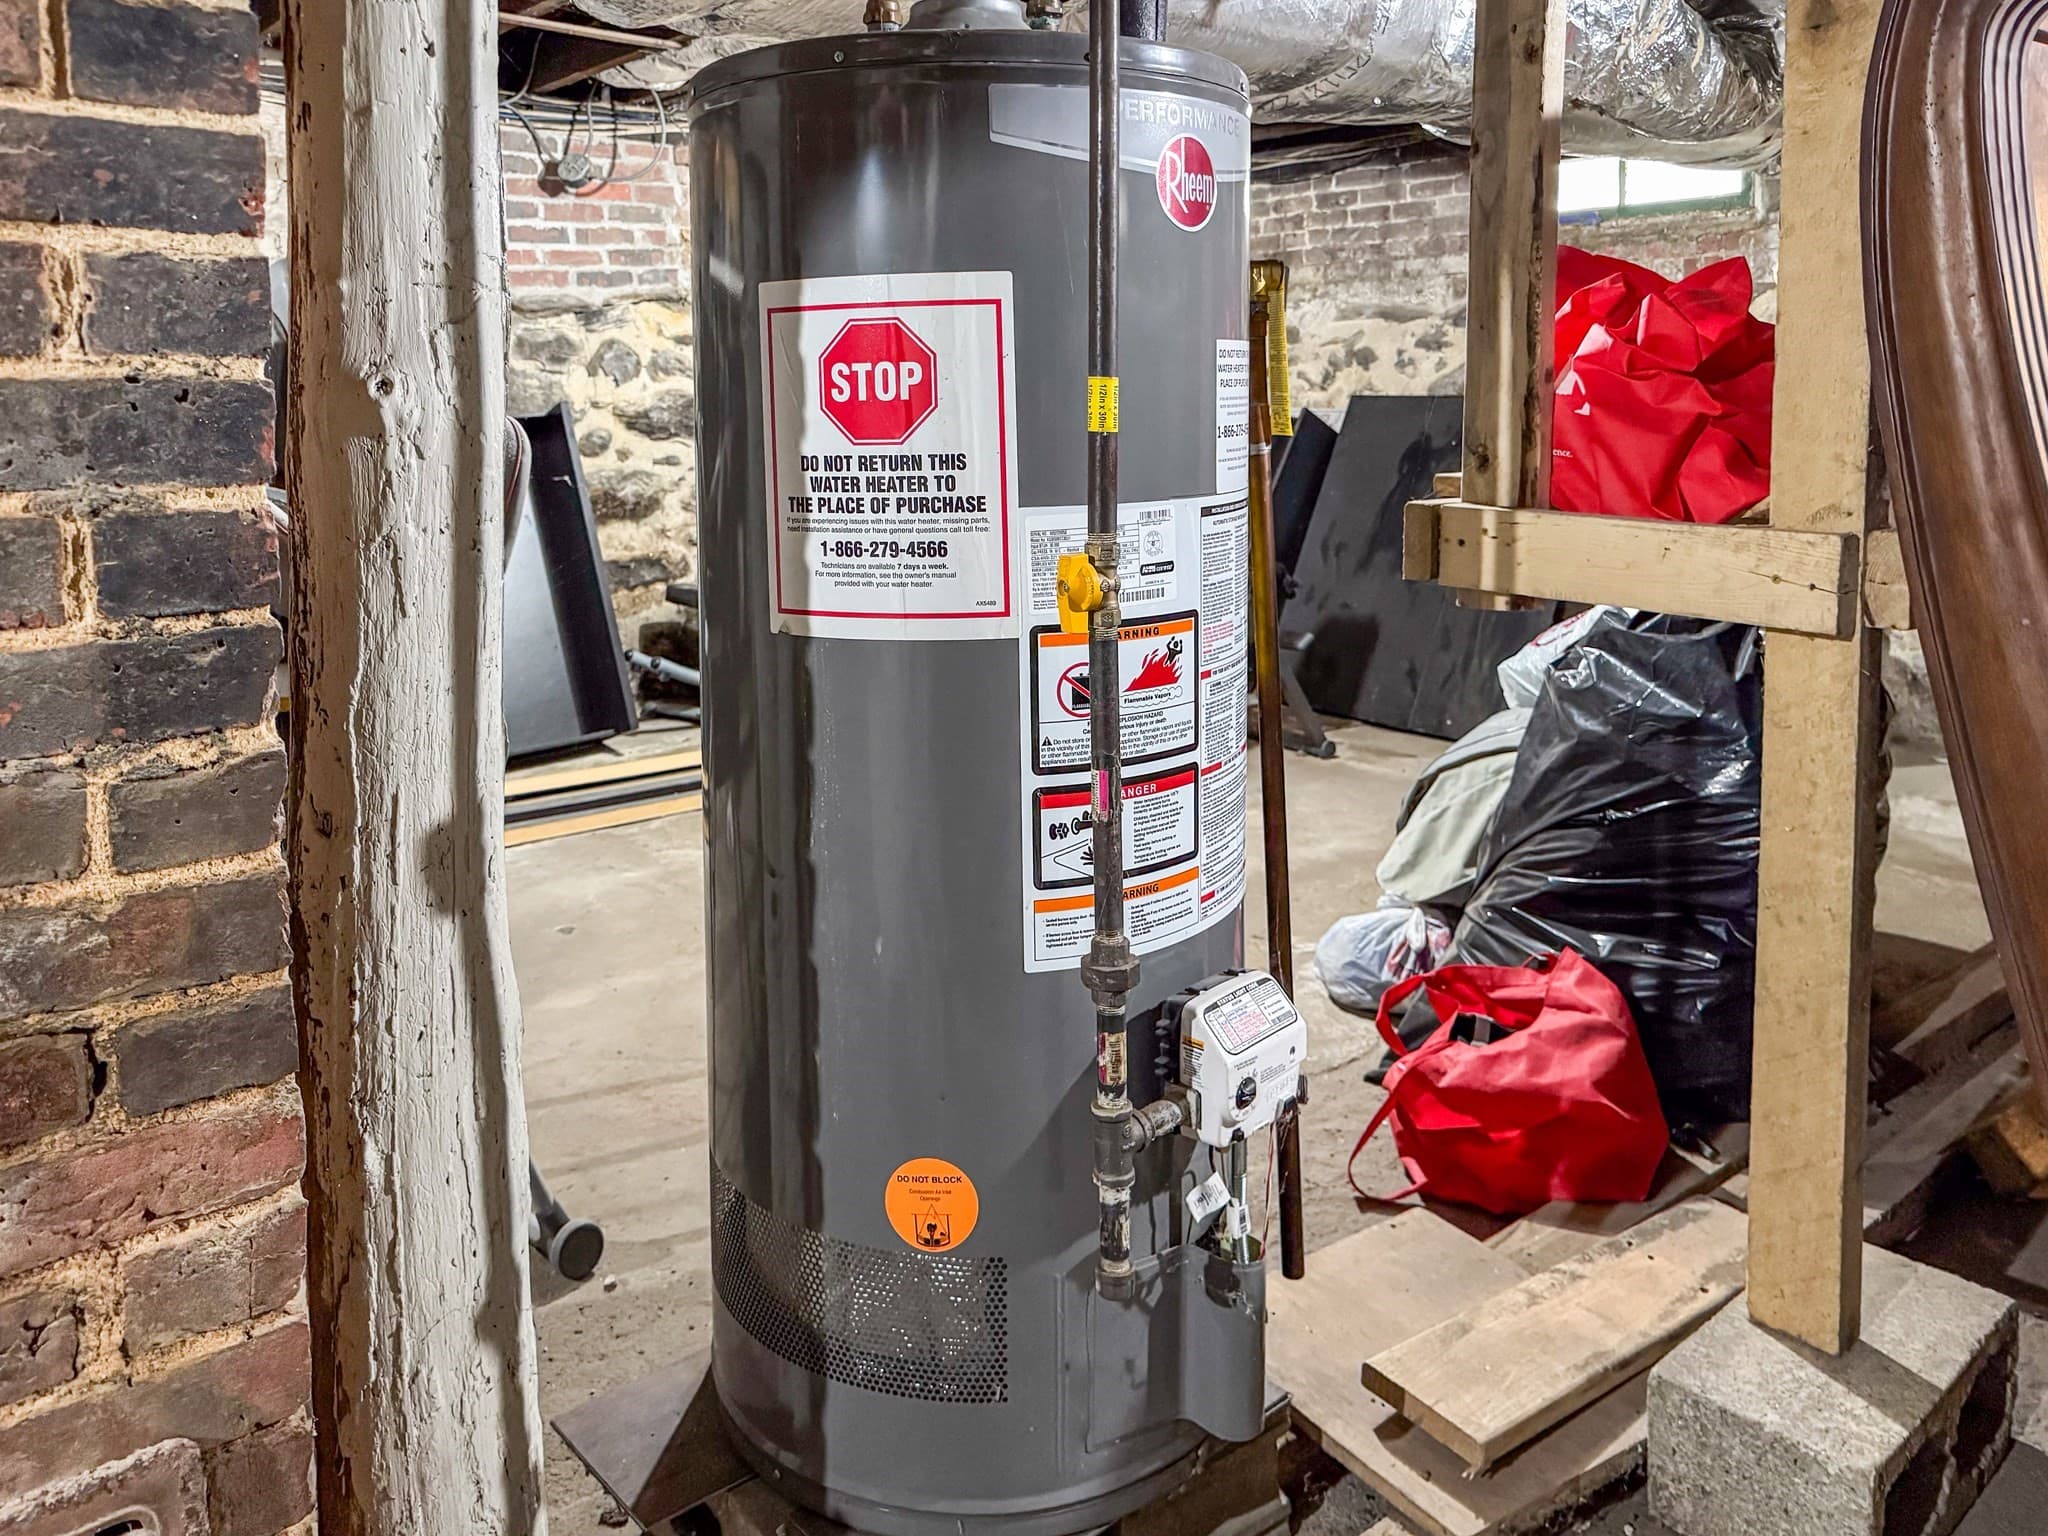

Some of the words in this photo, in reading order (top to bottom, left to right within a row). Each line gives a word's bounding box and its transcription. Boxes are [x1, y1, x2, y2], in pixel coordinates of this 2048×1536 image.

[1122, 99, 1240, 137] ERFORMANCE
[1165, 138, 1213, 213] Rheem
[830, 361, 923, 402] STOP
[1553, 449, 1573, 458] ence.
[801, 455, 818, 472] DO
[824, 455, 852, 472] NOT
[858, 454, 923, 472] RETURN
[928, 453, 967, 471] THIS
[810, 476, 861, 493] WATER
[866, 475, 929, 493] HEATER
[934, 474, 956, 492] TO
[788, 496, 813, 513] THE
[818, 497, 865, 514] PLACE
[870, 497, 890, 514] OF
[896, 496, 987, 514] PURCHASE
[812, 518, 848, 526] experiencing
[943, 518, 969, 526] missing
[888, 527, 914, 535] general
[916, 527, 948, 535] questions
[820, 540, 948, 558] 1-866-279-4566
[821, 562, 855, 570] Technicians
[903, 563, 920, 571] days
[842, 571, 878, 579] information,
[834, 580, 860, 588] provided
[1118, 626, 1160, 641] ARNING
[1124, 695, 1153, 704] Flammable
[1062, 750, 1088, 758] flammable
[1041, 758, 1066, 767] appliance
[1121, 784, 1157, 799] ANGER
[1123, 884, 1159, 900] ARNING
[897, 1175, 910, 1183] DO
[912, 1176, 929, 1184] NOT
[932, 1176, 962, 1184] BLOCK
